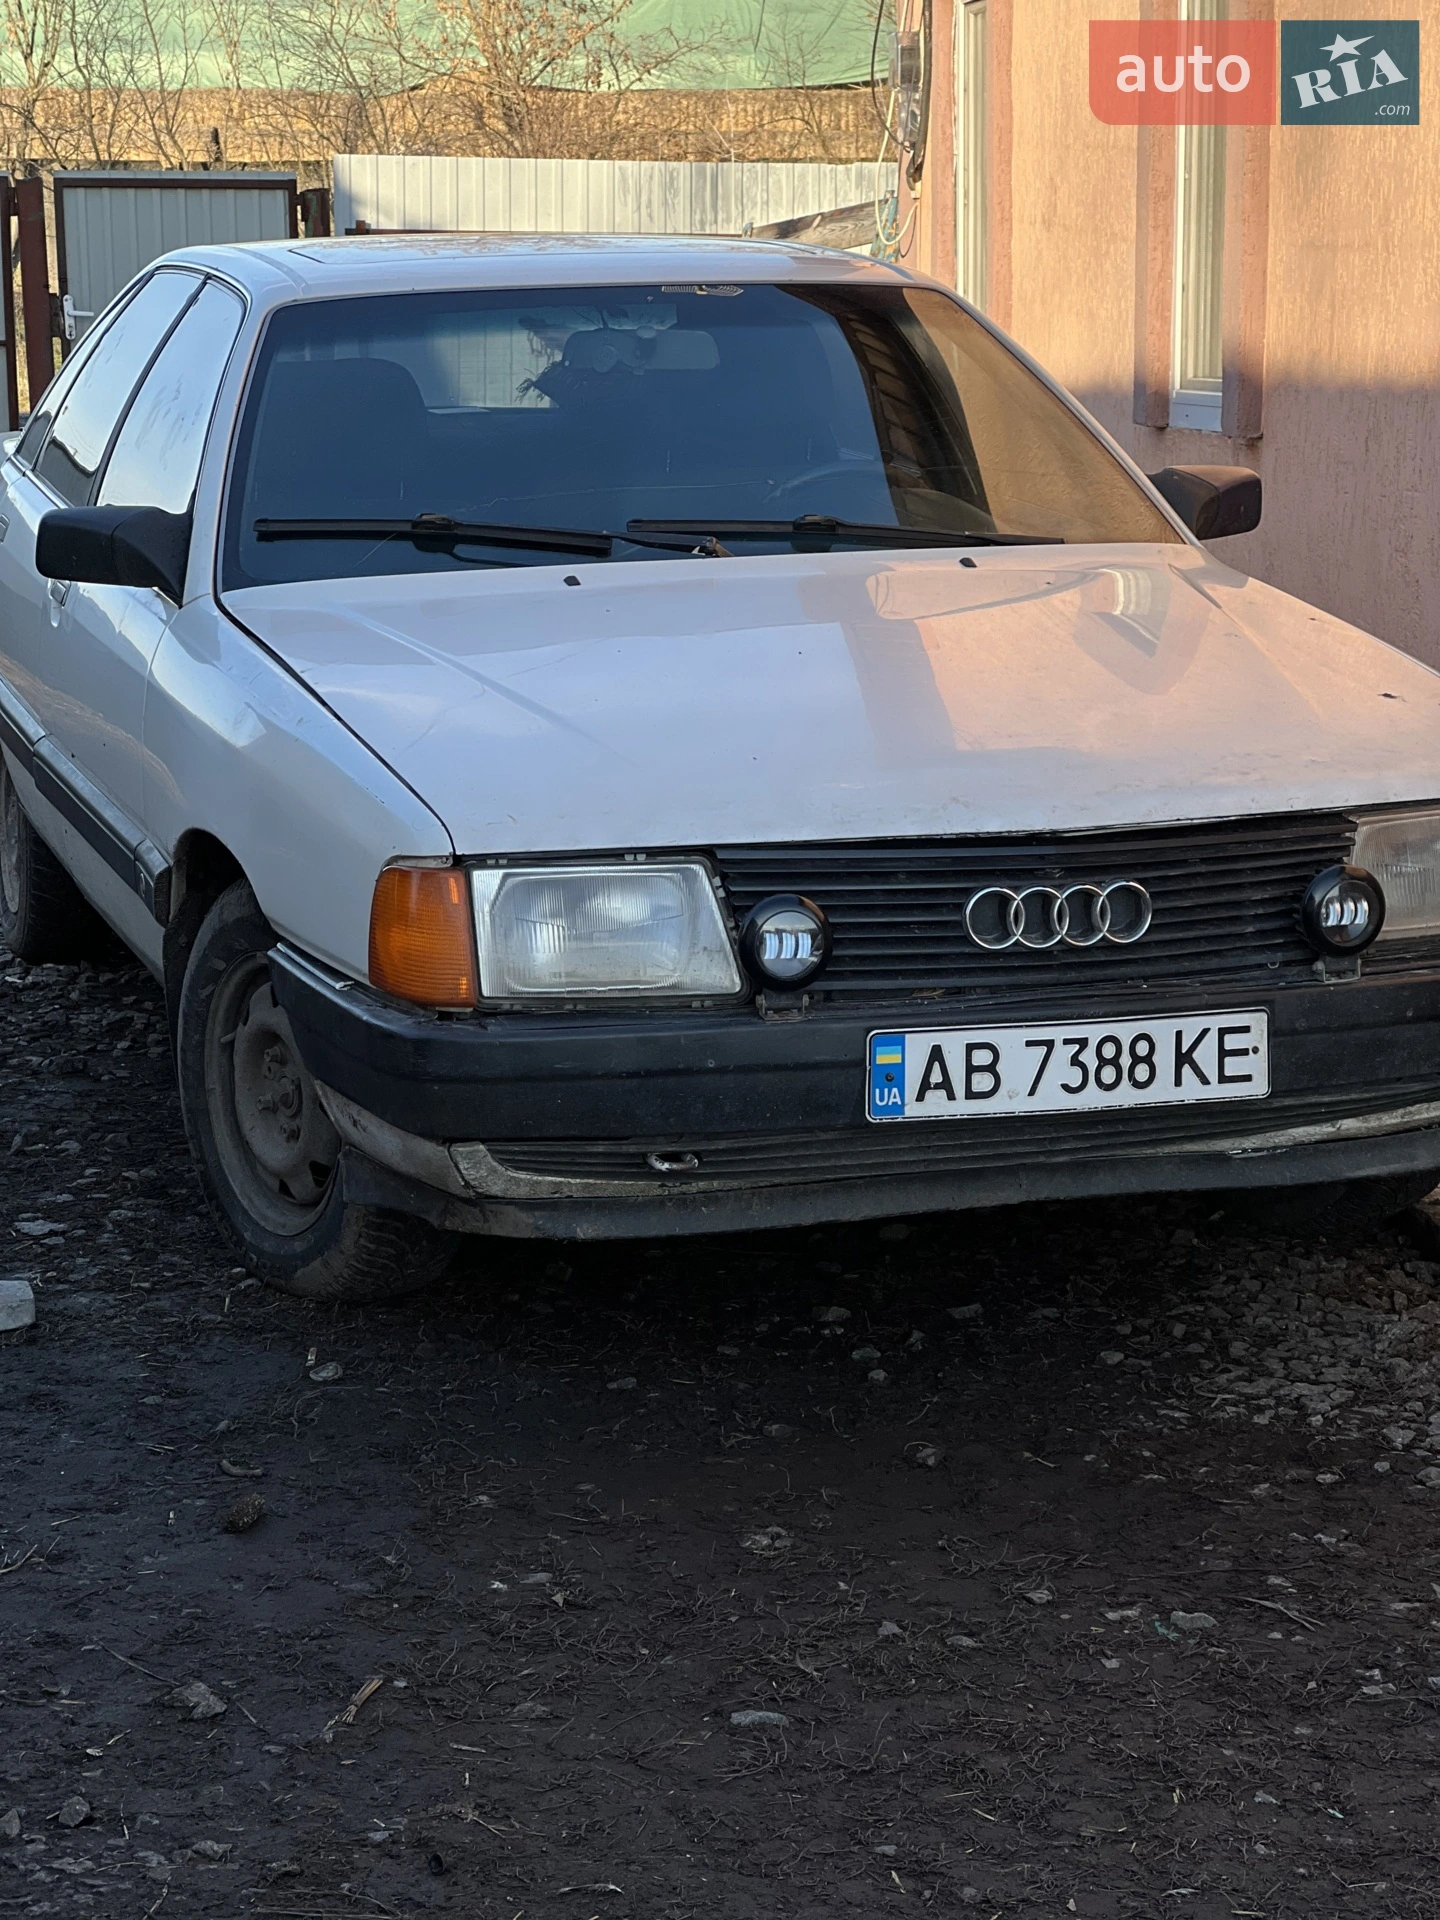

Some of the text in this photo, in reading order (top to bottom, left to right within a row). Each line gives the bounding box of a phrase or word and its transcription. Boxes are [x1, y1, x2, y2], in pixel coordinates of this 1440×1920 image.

[914, 1025, 1253, 1103] AB 7388 KE
[875, 1087, 902, 1106] UA
